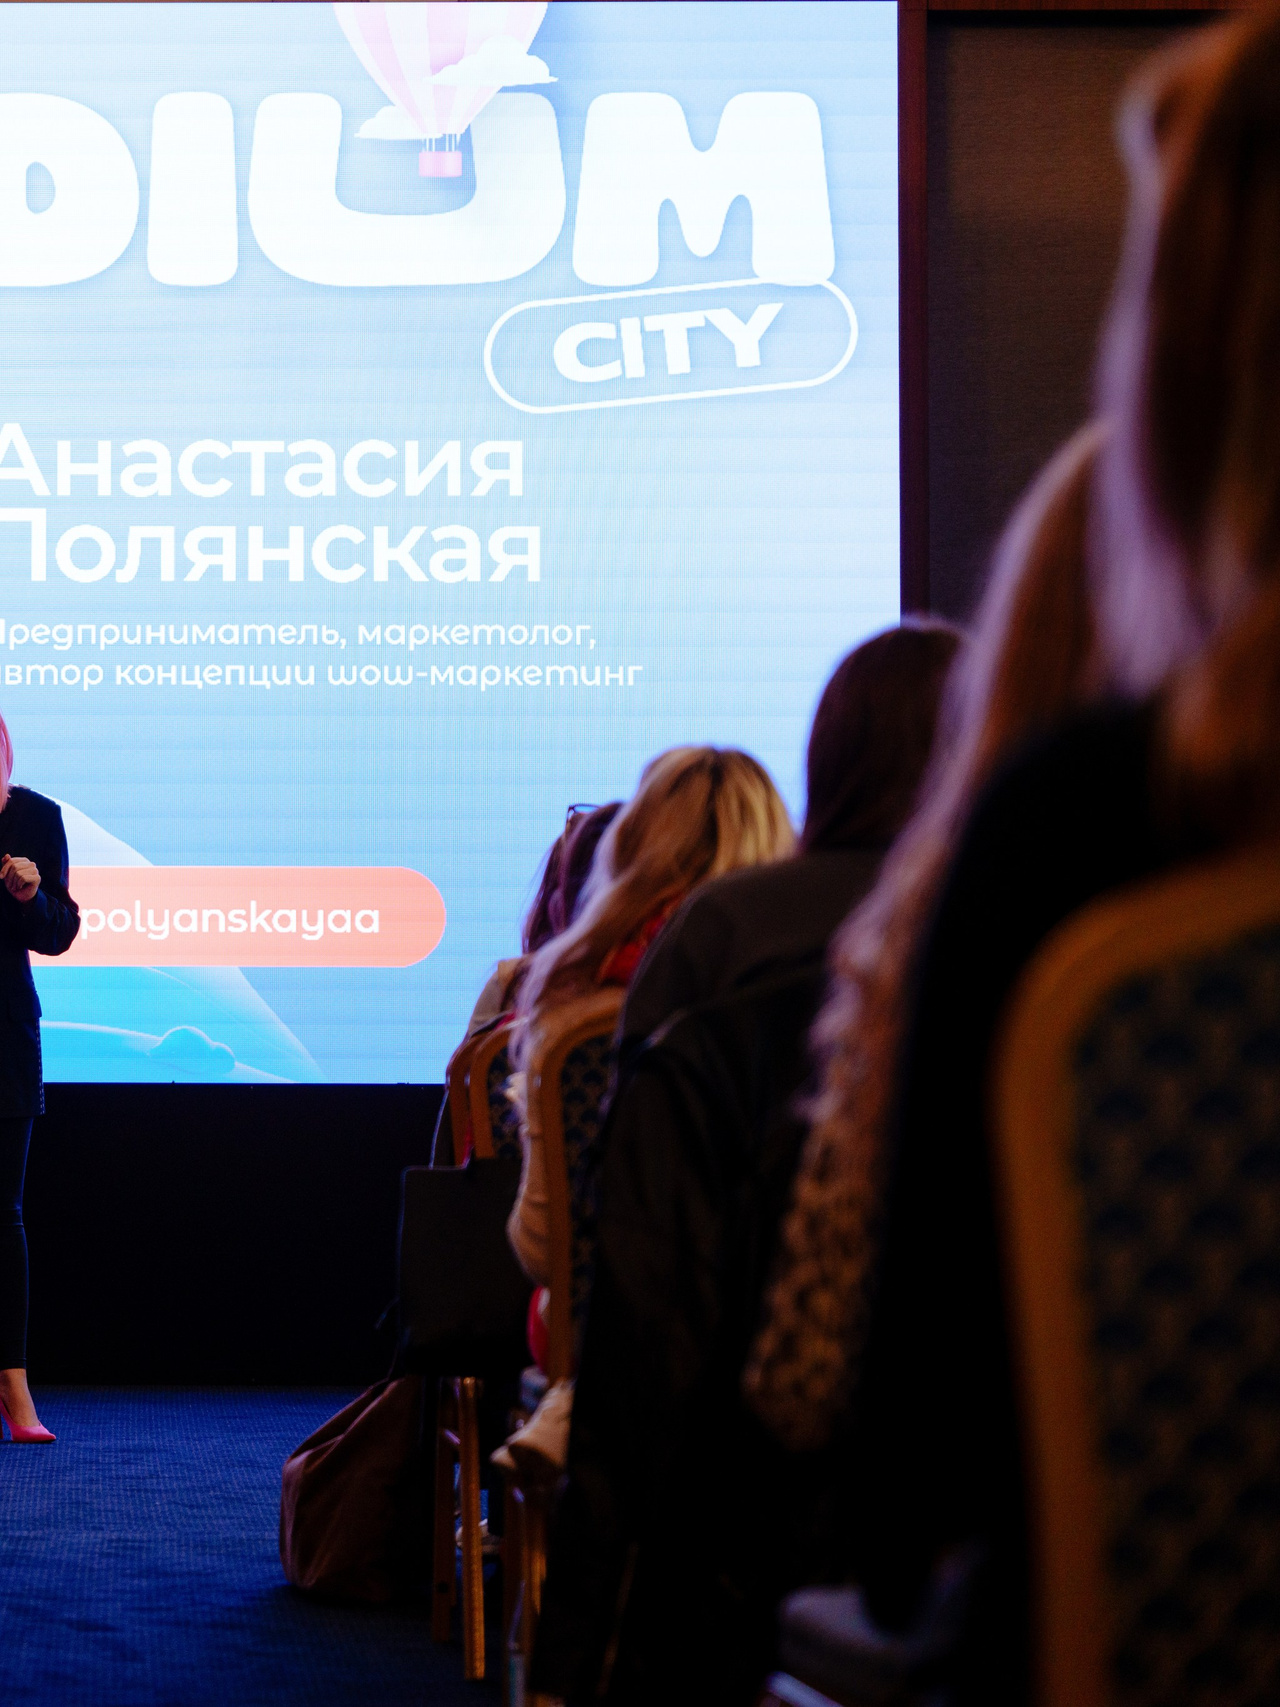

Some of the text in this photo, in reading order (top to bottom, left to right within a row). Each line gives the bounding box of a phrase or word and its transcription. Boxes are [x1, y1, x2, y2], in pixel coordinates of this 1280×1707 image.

[552, 303, 784, 384] CITY
[357, 617, 596, 651] маркетолог,
[115, 662, 316, 692] концепции
[81, 899, 380, 941] polyanskayaa
